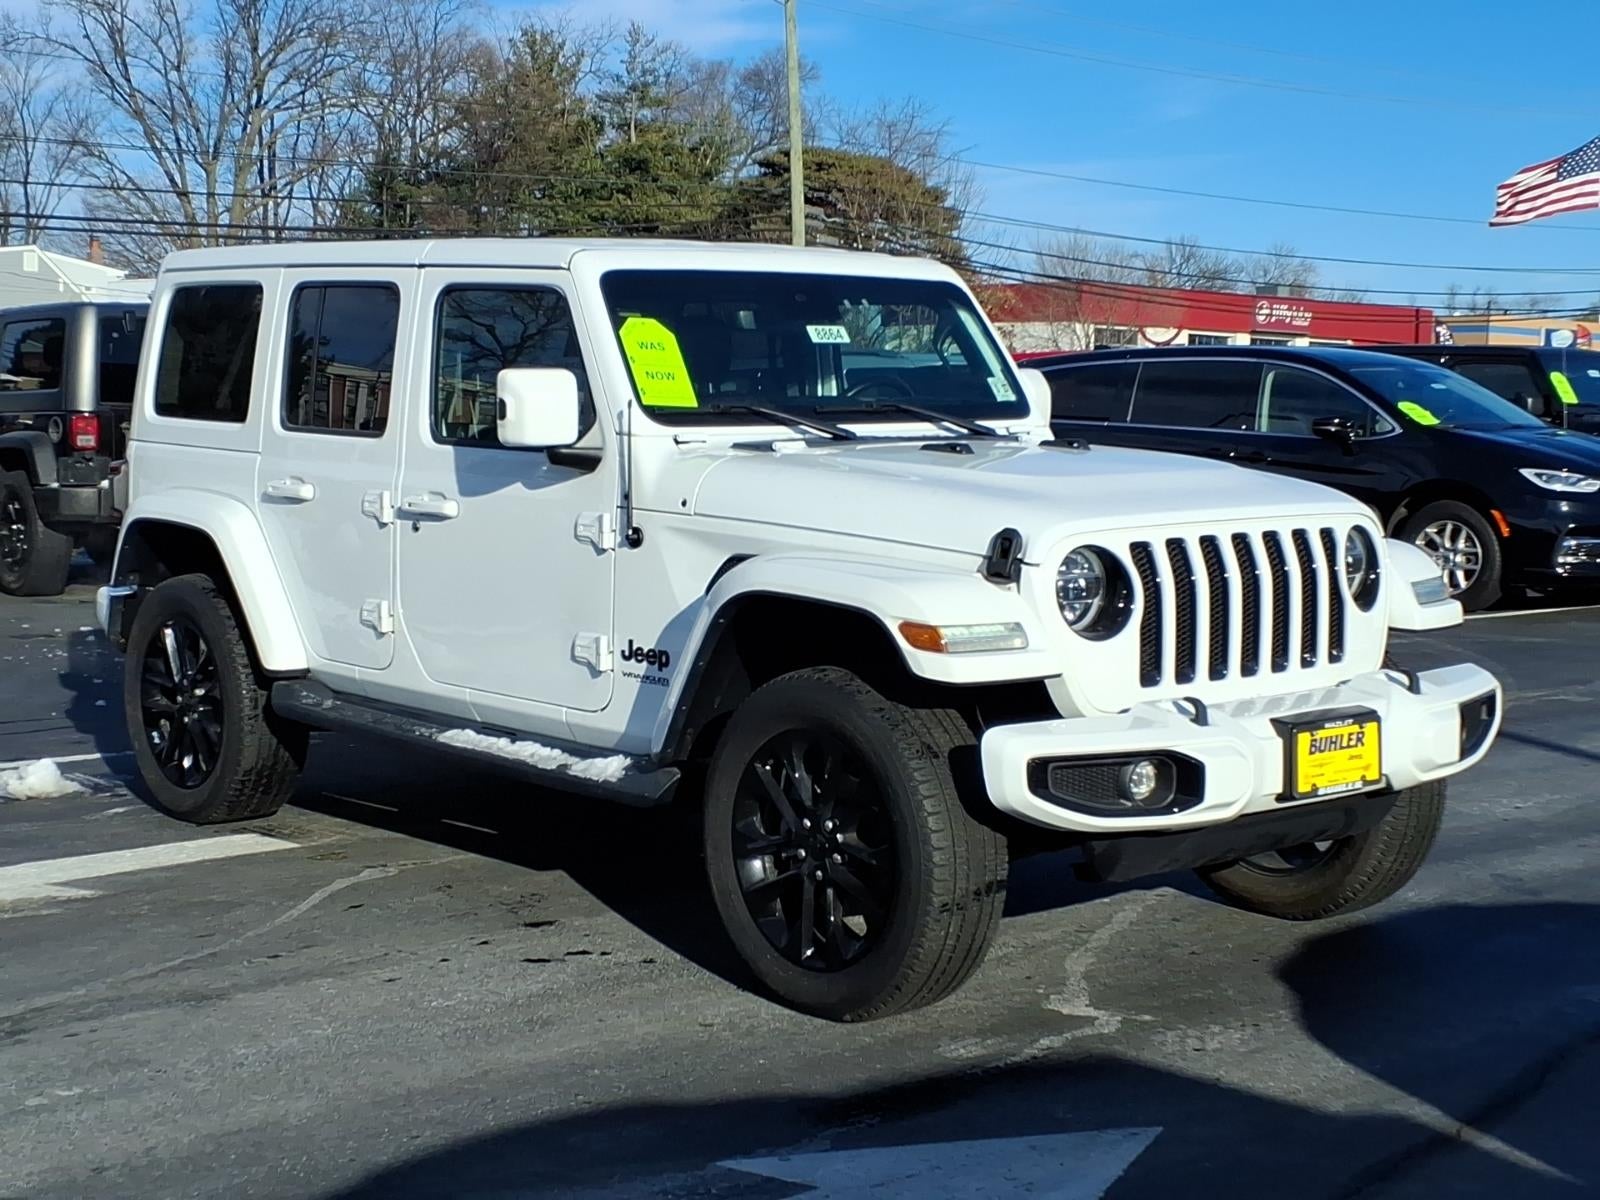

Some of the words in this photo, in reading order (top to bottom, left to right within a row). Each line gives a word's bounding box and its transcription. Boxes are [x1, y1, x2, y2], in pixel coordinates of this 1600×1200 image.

[814, 327, 844, 341] 8864
[636, 341, 666, 352] WAS
[645, 370, 676, 381] NOW
[621, 639, 670, 672] Jeep
[1308, 730, 1366, 756] BUHLER
